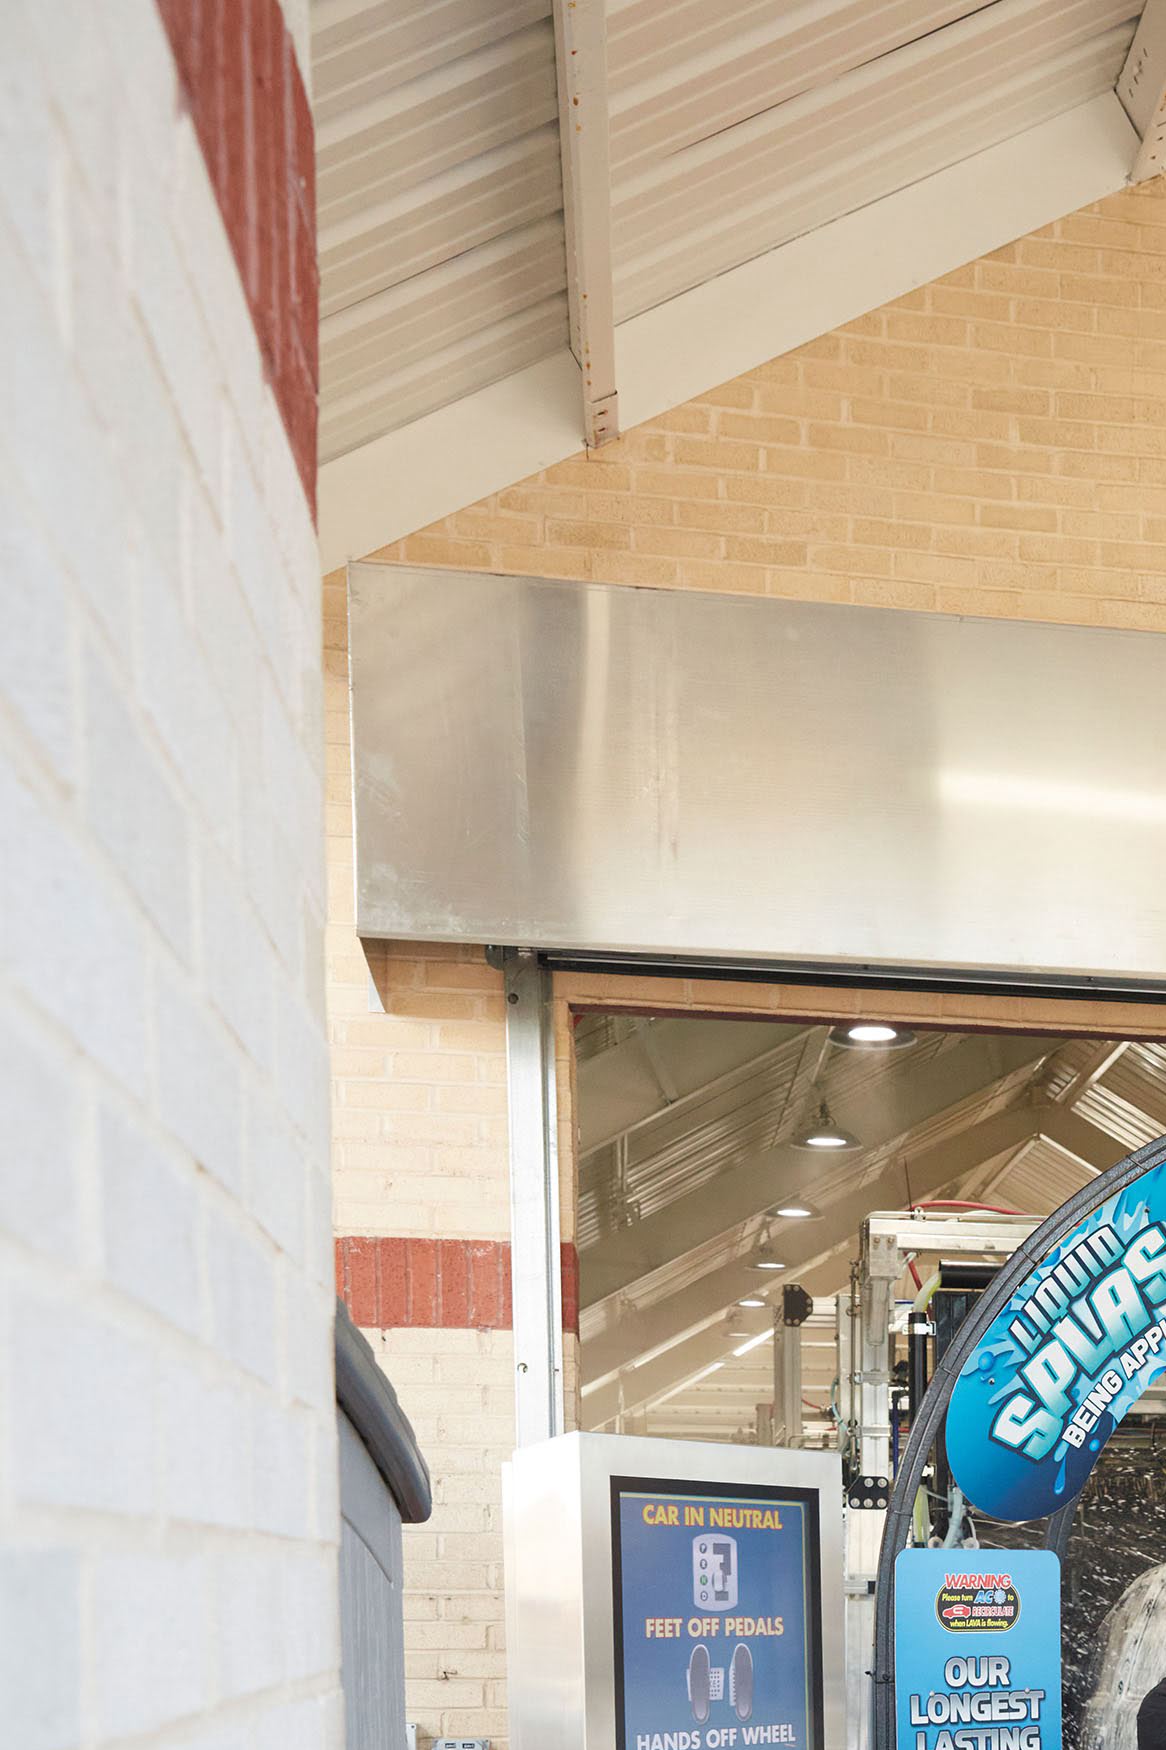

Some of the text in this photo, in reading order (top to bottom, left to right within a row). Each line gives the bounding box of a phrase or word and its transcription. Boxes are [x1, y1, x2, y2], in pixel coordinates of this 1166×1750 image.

[1008, 1224, 1126, 1354] LIQUID
[1062, 1369, 1123, 1448] BEING
[642, 1504, 783, 1530] CAR IN NEUTRAL
[945, 1574, 1011, 1589] WARNING
[942, 1593, 960, 1601] Please
[974, 1590, 993, 1604] AC
[950, 1619, 965, 1627] when
[966, 1619, 980, 1627] LAVA
[972, 1606, 1014, 1616] RECIRCULATE
[645, 1616, 784, 1638] FEET OFF PEDALS
[945, 1656, 1010, 1687] OUR
[910, 1689, 1045, 1725] LONGEST
[706, 1728, 737, 1748] OFF
[742, 1724, 796, 1745] WHEEL
